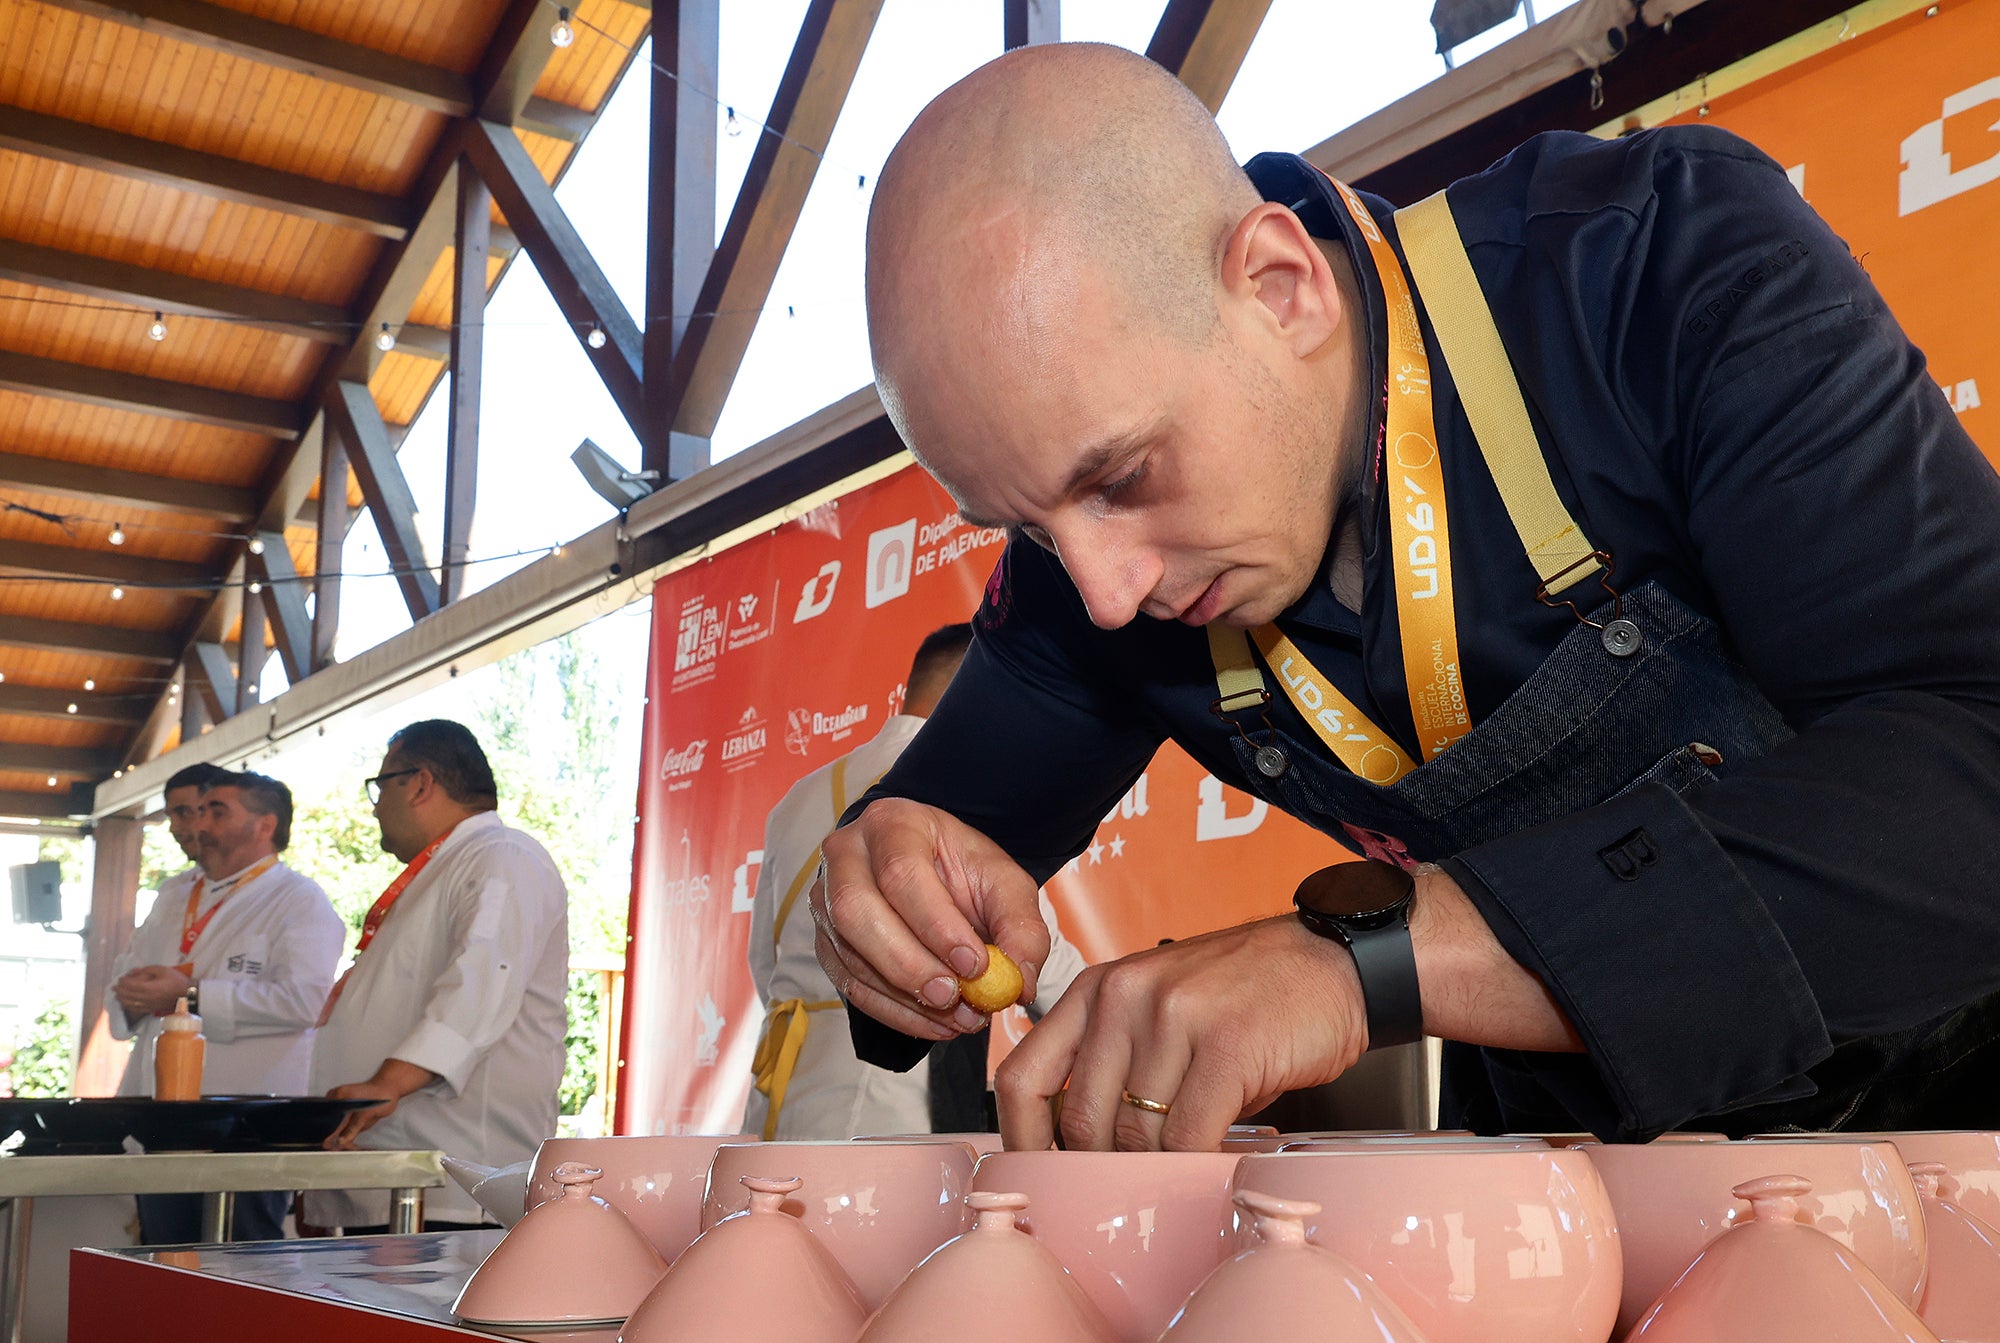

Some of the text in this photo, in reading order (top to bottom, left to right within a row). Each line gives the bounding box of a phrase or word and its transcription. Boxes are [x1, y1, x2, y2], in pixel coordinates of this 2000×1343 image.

[918, 513, 966, 546] Diputac
[915, 527, 1007, 576] DE PALENCIA
[700, 621, 724, 645] LEN
[702, 606, 718, 626] PA
[697, 641, 717, 663] CIA
[1432, 637, 1455, 727] INTERNACIONAL
[1446, 662, 1467, 725] DE COCINA
[1426, 683, 1444, 728] ESCUELA
